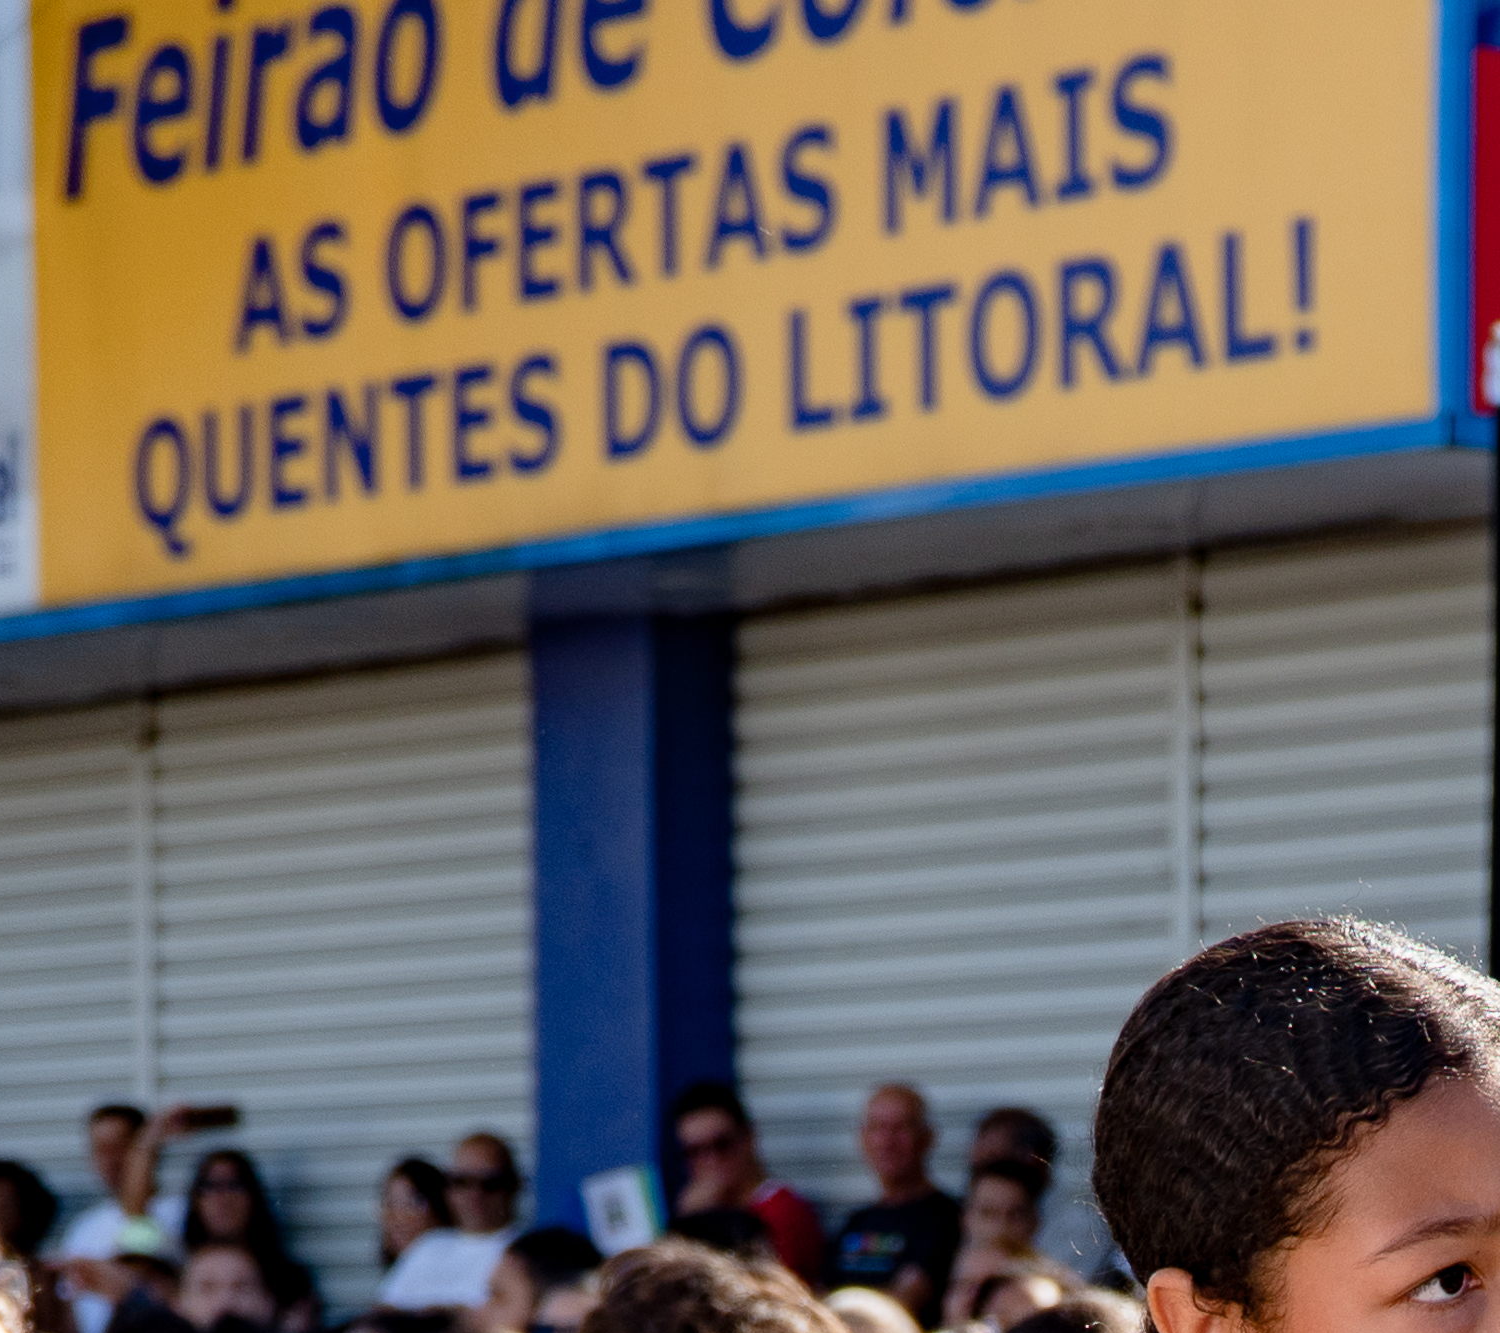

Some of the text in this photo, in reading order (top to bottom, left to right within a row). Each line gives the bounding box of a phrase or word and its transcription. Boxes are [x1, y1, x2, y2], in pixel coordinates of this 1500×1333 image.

[234, 53, 1175, 351] AS OFERTAS MAIS
[134, 217, 1315, 556] QUENTES DO LITORAL!
